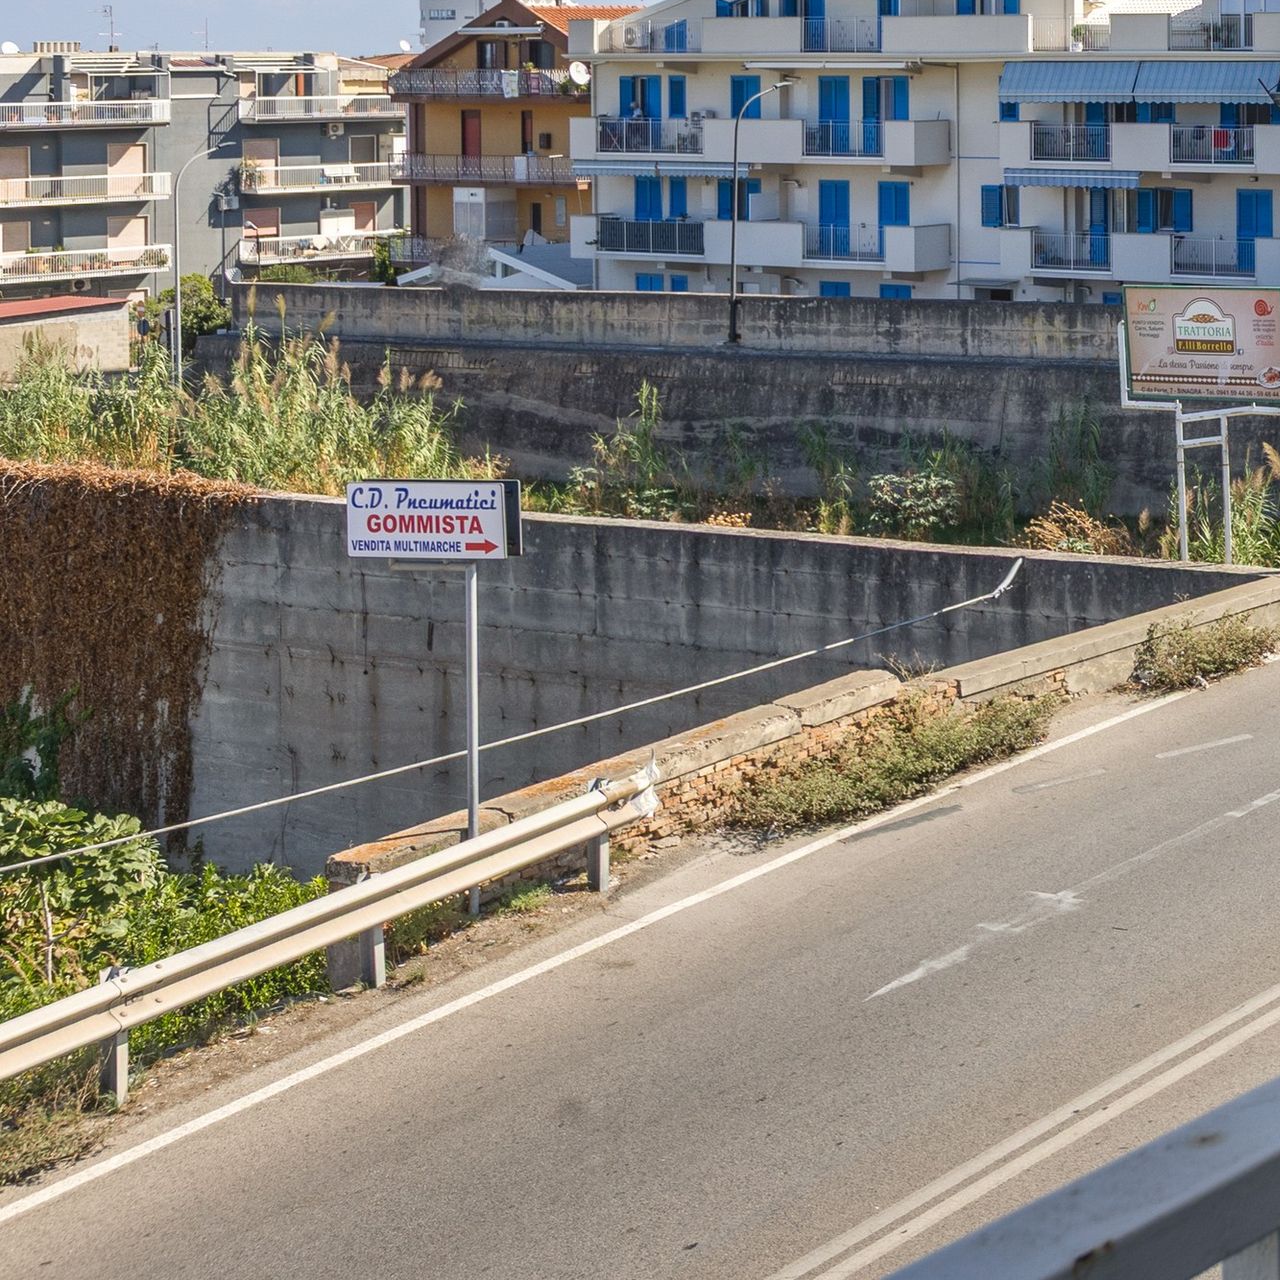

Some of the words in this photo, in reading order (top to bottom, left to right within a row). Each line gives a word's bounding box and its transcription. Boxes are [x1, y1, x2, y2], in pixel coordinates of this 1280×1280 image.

[1177, 326, 1232, 337] TRATTORIA
[1196, 341, 1233, 352] Borrello
[1158, 359, 1168, 368] La
[1189, 359, 1219, 370] Passione
[351, 487, 388, 510] C.D.
[394, 487, 497, 510] Pneumatici
[366, 513, 484, 534] GOMMISTA
[351, 540, 391, 552] VENDITA
[394, 540, 462, 553] MULTIMARCHE
